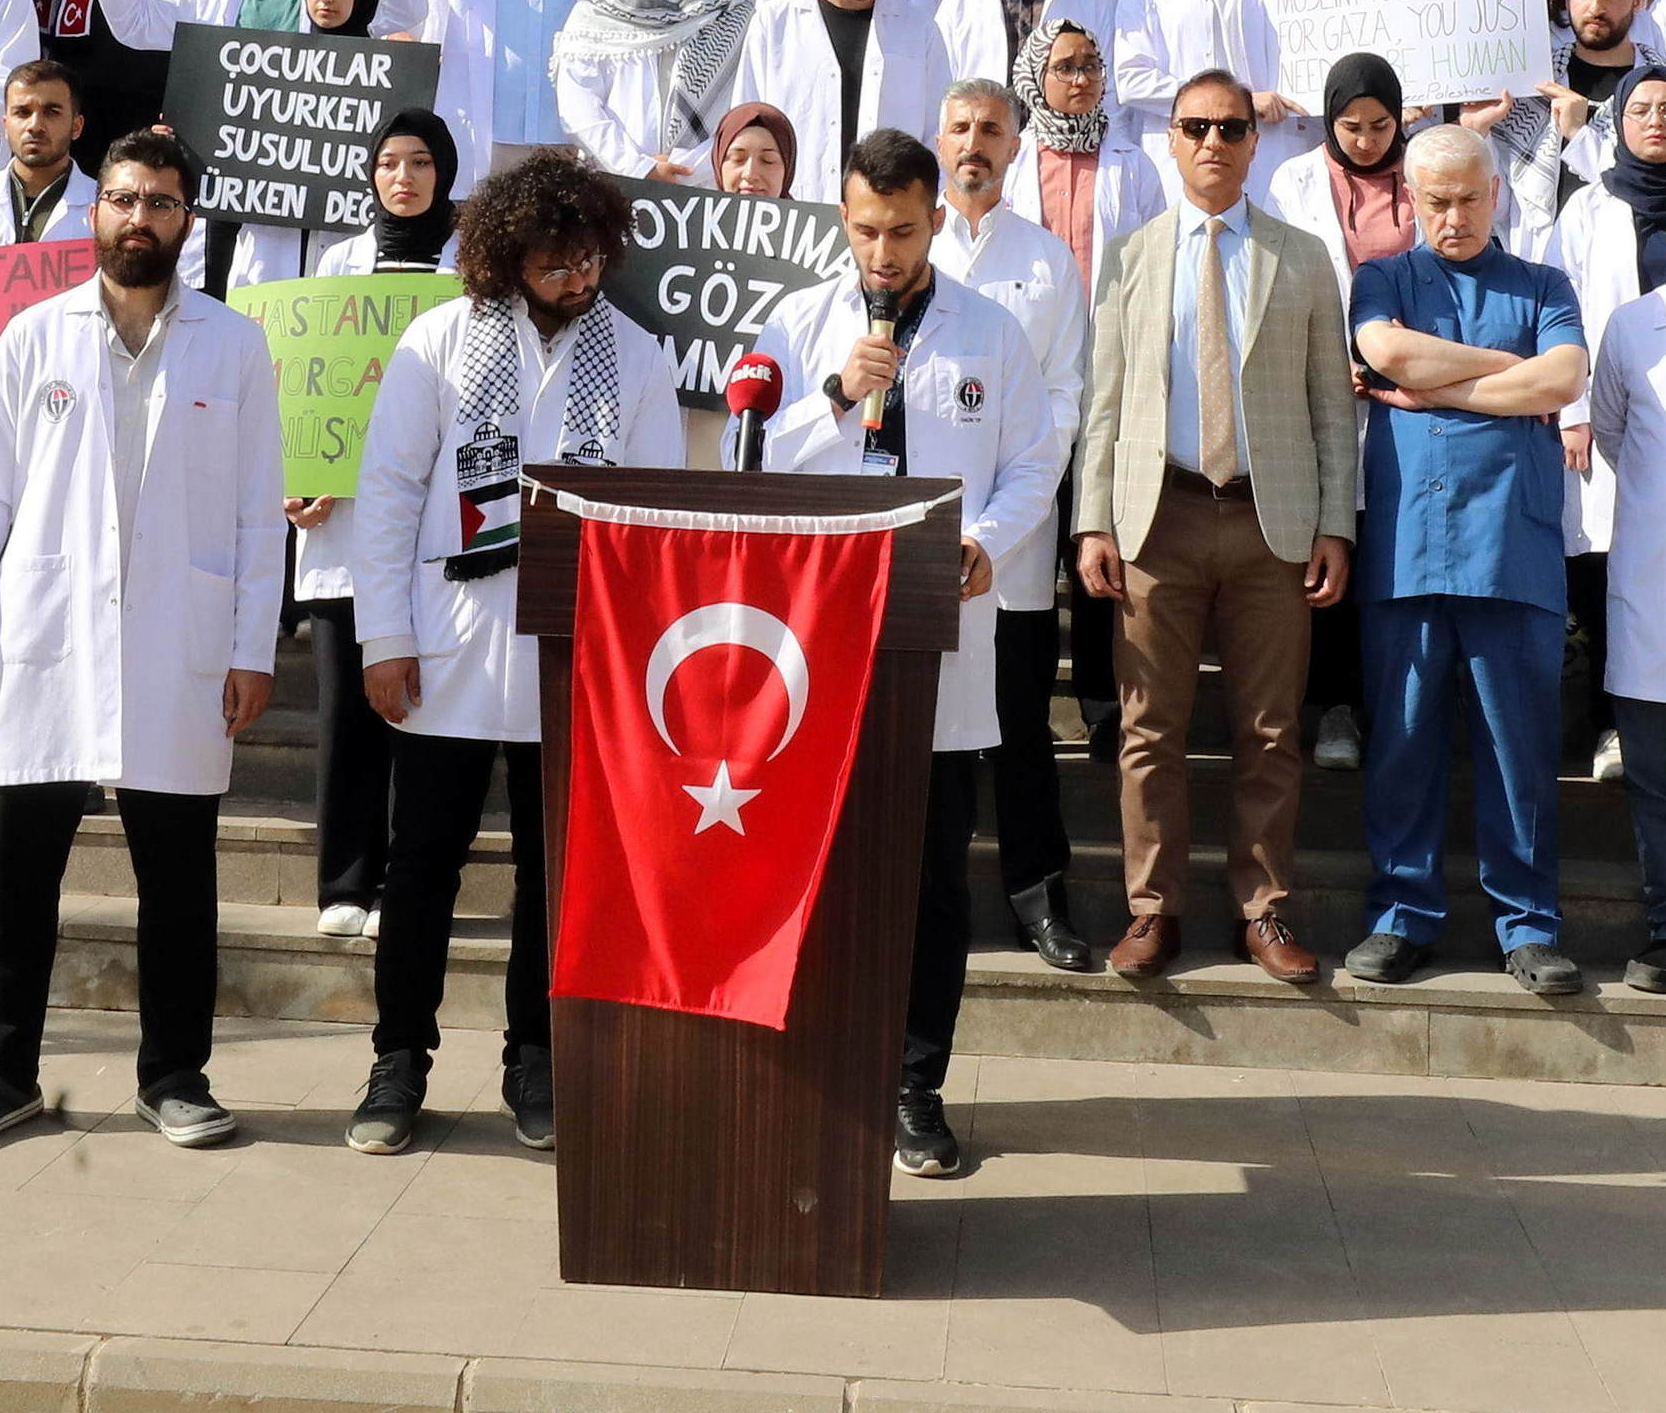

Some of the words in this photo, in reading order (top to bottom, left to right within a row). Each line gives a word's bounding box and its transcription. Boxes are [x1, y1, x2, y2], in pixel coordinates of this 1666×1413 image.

[1277, 18, 1317, 54] FOR
[1406, 2, 1456, 40] YOU
[219, 41, 392, 88] ÇOCUKLAR
[1386, 47, 1416, 83] BE
[1432, 38, 1527, 81] HUMAN
[223, 83, 382, 134] UYURKEN
[214, 125, 368, 181] SUSULUR
[194, 166, 307, 219] ÜRKEN
[657, 260, 784, 335] GÖZ
[731, 364, 773, 383] akit
